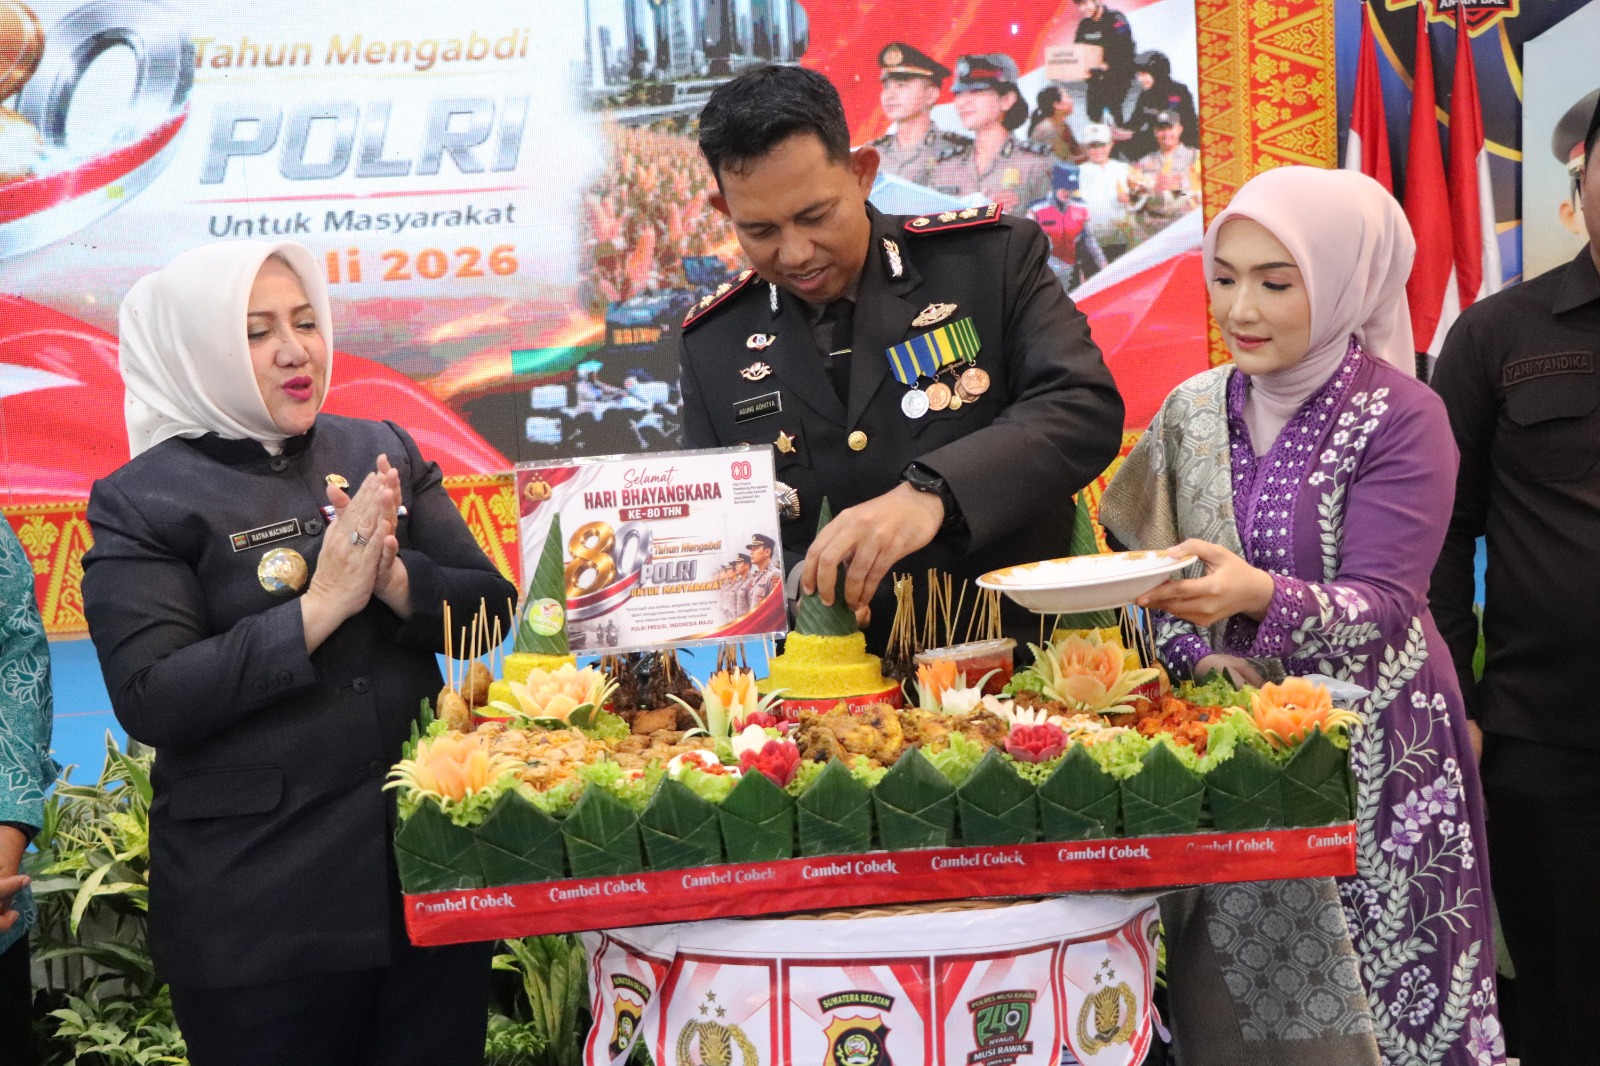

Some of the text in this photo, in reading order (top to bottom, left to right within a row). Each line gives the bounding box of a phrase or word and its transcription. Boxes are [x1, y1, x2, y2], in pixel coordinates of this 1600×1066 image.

[191, 28, 531, 72] Tahun Mengabdi
[200, 94, 532, 185] POLRI
[208, 203, 517, 238] Untuk Masyarakat
[326, 244, 519, 285] li 2026
[1506, 355, 1589, 380] YANI YANDIKA
[739, 405, 755, 416] AGUNG
[624, 466, 679, 489] Selamat
[731, 460, 752, 480] 80
[584, 482, 723, 510] HARI BHAYANGKARA
[628, 506, 682, 520] KE-80 THN
[251, 530, 269, 541] RATNA
[654, 540, 722, 556] Tahun Mengabdi
[565, 520, 653, 599] 80
[639, 559, 698, 585] POLRI
[630, 580, 724, 598] UNTUK MASYARAKAT
[669, 621, 698, 629] INDONESIA
[1186, 837, 1278, 853] Cmbel Cobek
[1307, 832, 1353, 849] Cambel
[931, 850, 1027, 870] Cambel Cobek
[1058, 844, 1152, 862] Cambel Cobek
[681, 866, 777, 889] Cambel Cobek
[802, 859, 900, 880] Cambel Cobek
[549, 878, 649, 902] Cambel Cobek
[415, 893, 516, 914] Cambel Cobek
[822, 994, 891, 1008] SUMATERA SELATAN
[971, 995, 996, 1009] POLRES
[988, 1035, 1014, 1045] NYAGO
[973, 1044, 1027, 1061] MUSI RAWAS
